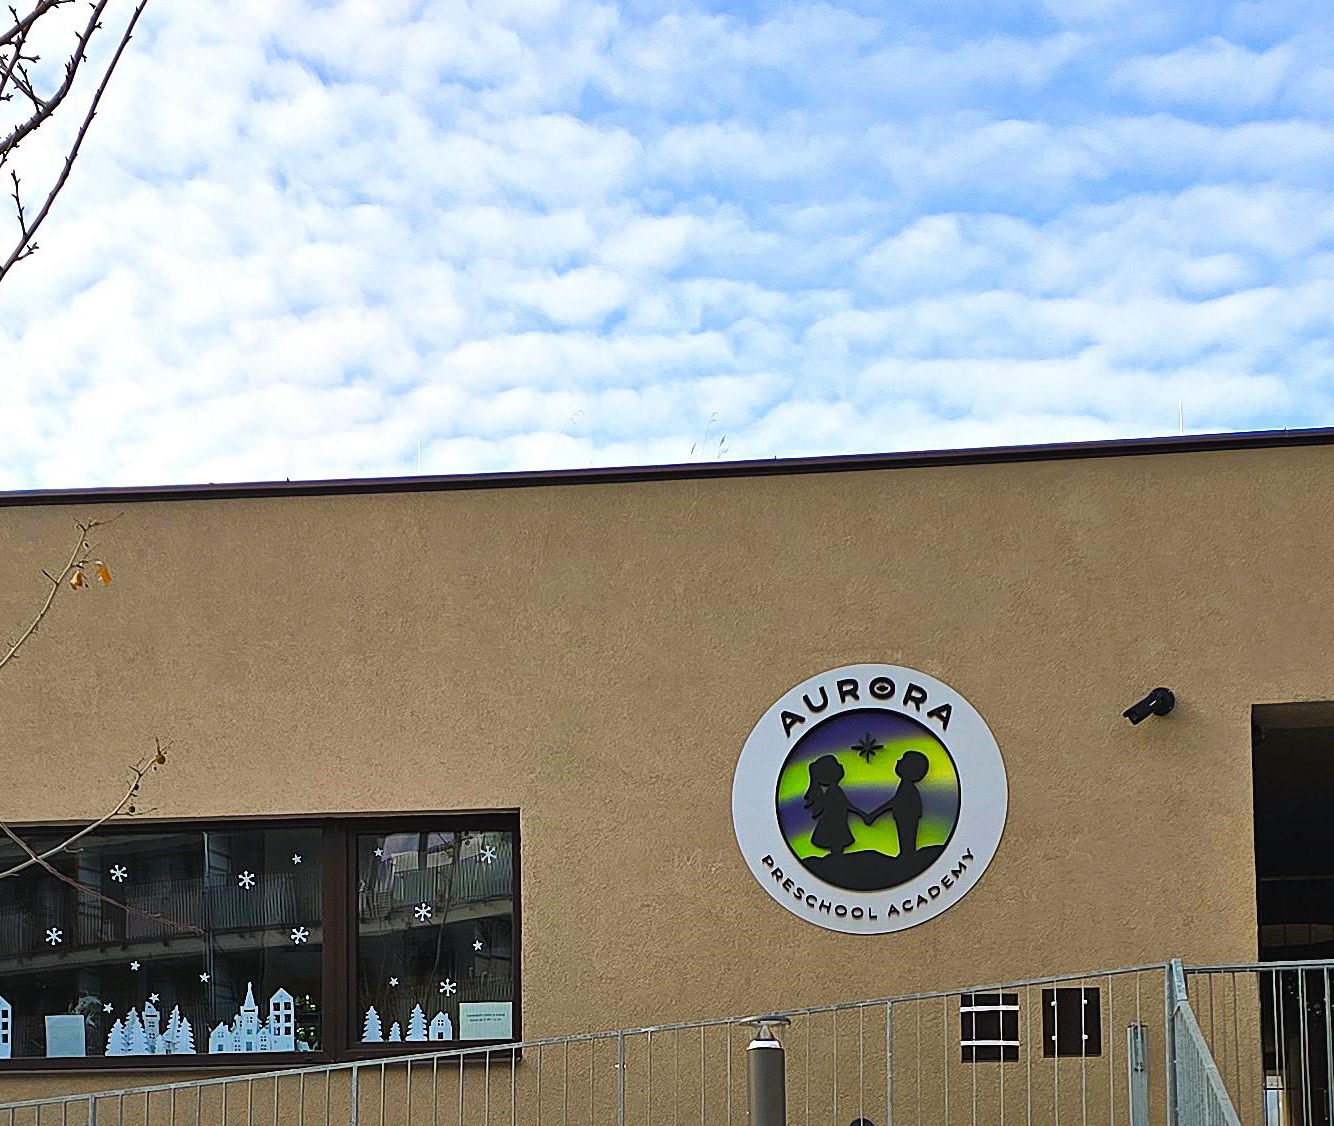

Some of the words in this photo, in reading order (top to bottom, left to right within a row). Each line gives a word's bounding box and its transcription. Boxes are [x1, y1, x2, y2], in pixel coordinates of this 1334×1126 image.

[780, 676, 953, 738] AURORA
[761, 854, 878, 920] PRESCHOOL
[887, 847, 975, 918] ACADEMY
